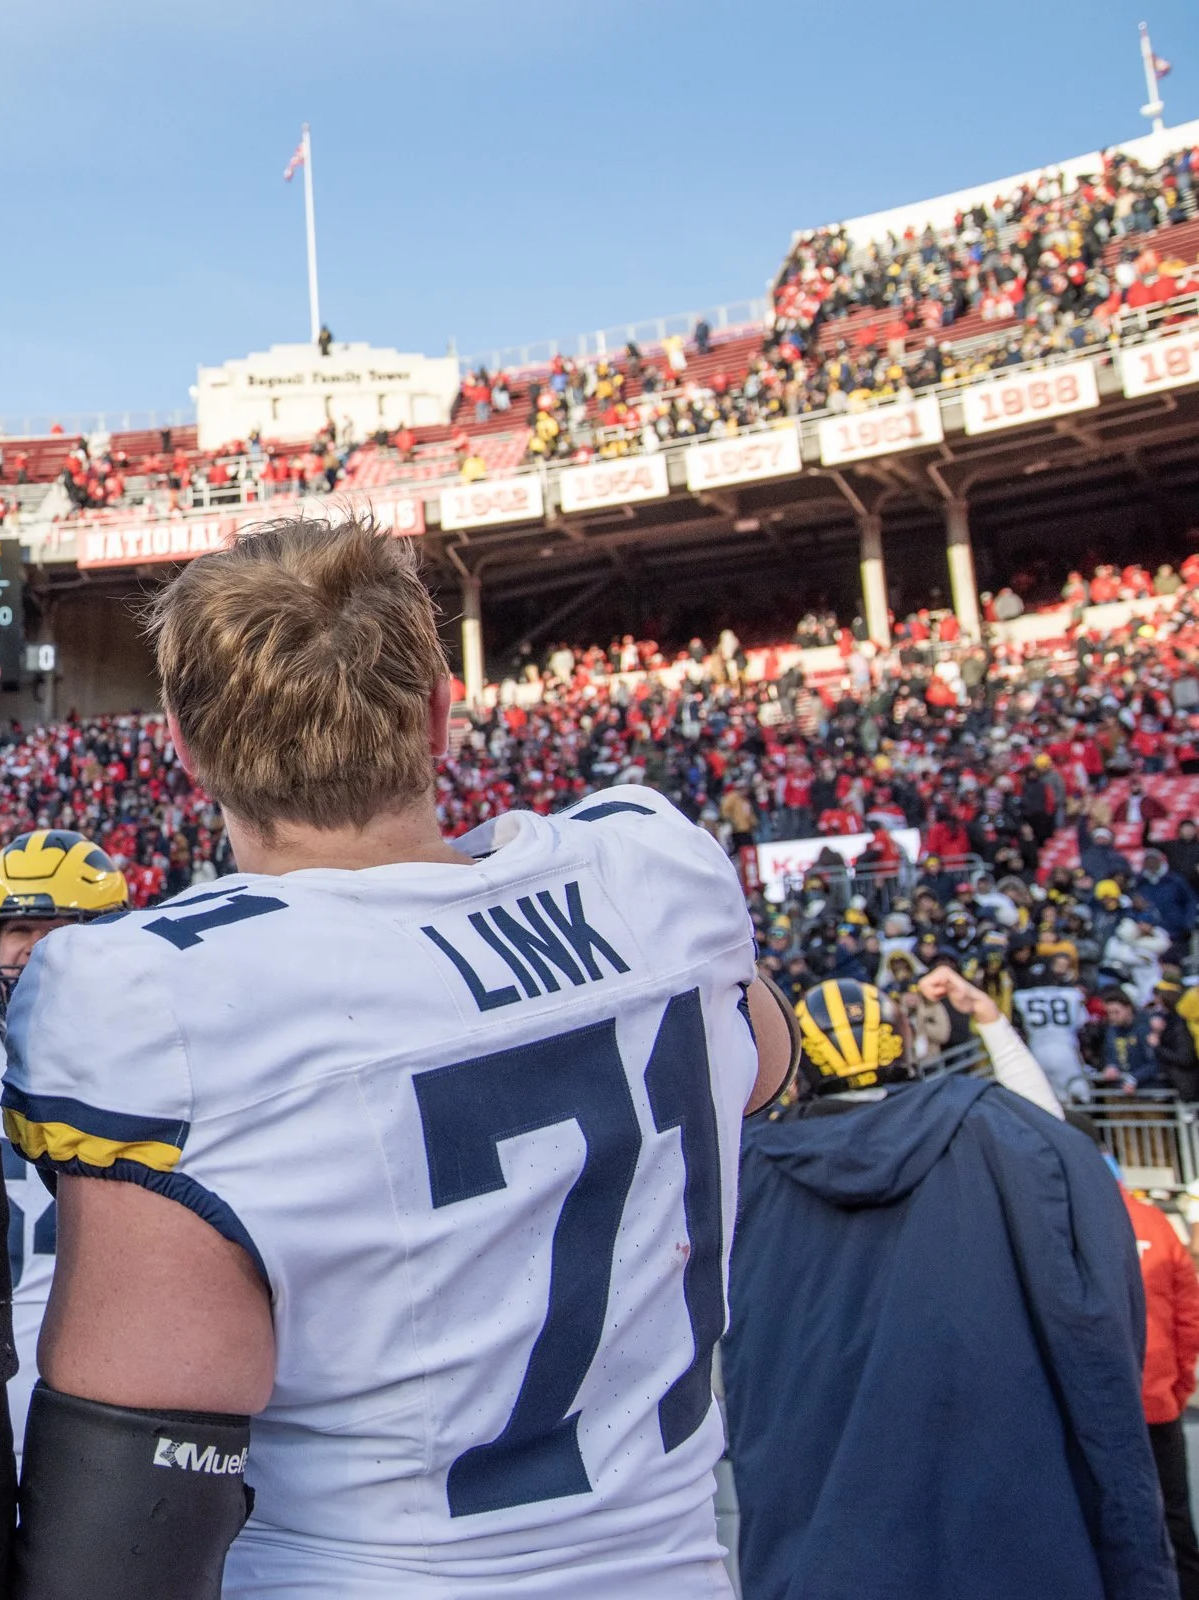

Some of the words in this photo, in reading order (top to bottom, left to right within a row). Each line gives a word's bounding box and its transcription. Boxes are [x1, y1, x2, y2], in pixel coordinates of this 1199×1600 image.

[1140, 340, 1199, 382] 19
[86, 522, 222, 560] NATIONAL
[420, 881, 631, 1011] LINK
[1027, 999, 1071, 1027] 58
[412, 987, 730, 1518] 71
